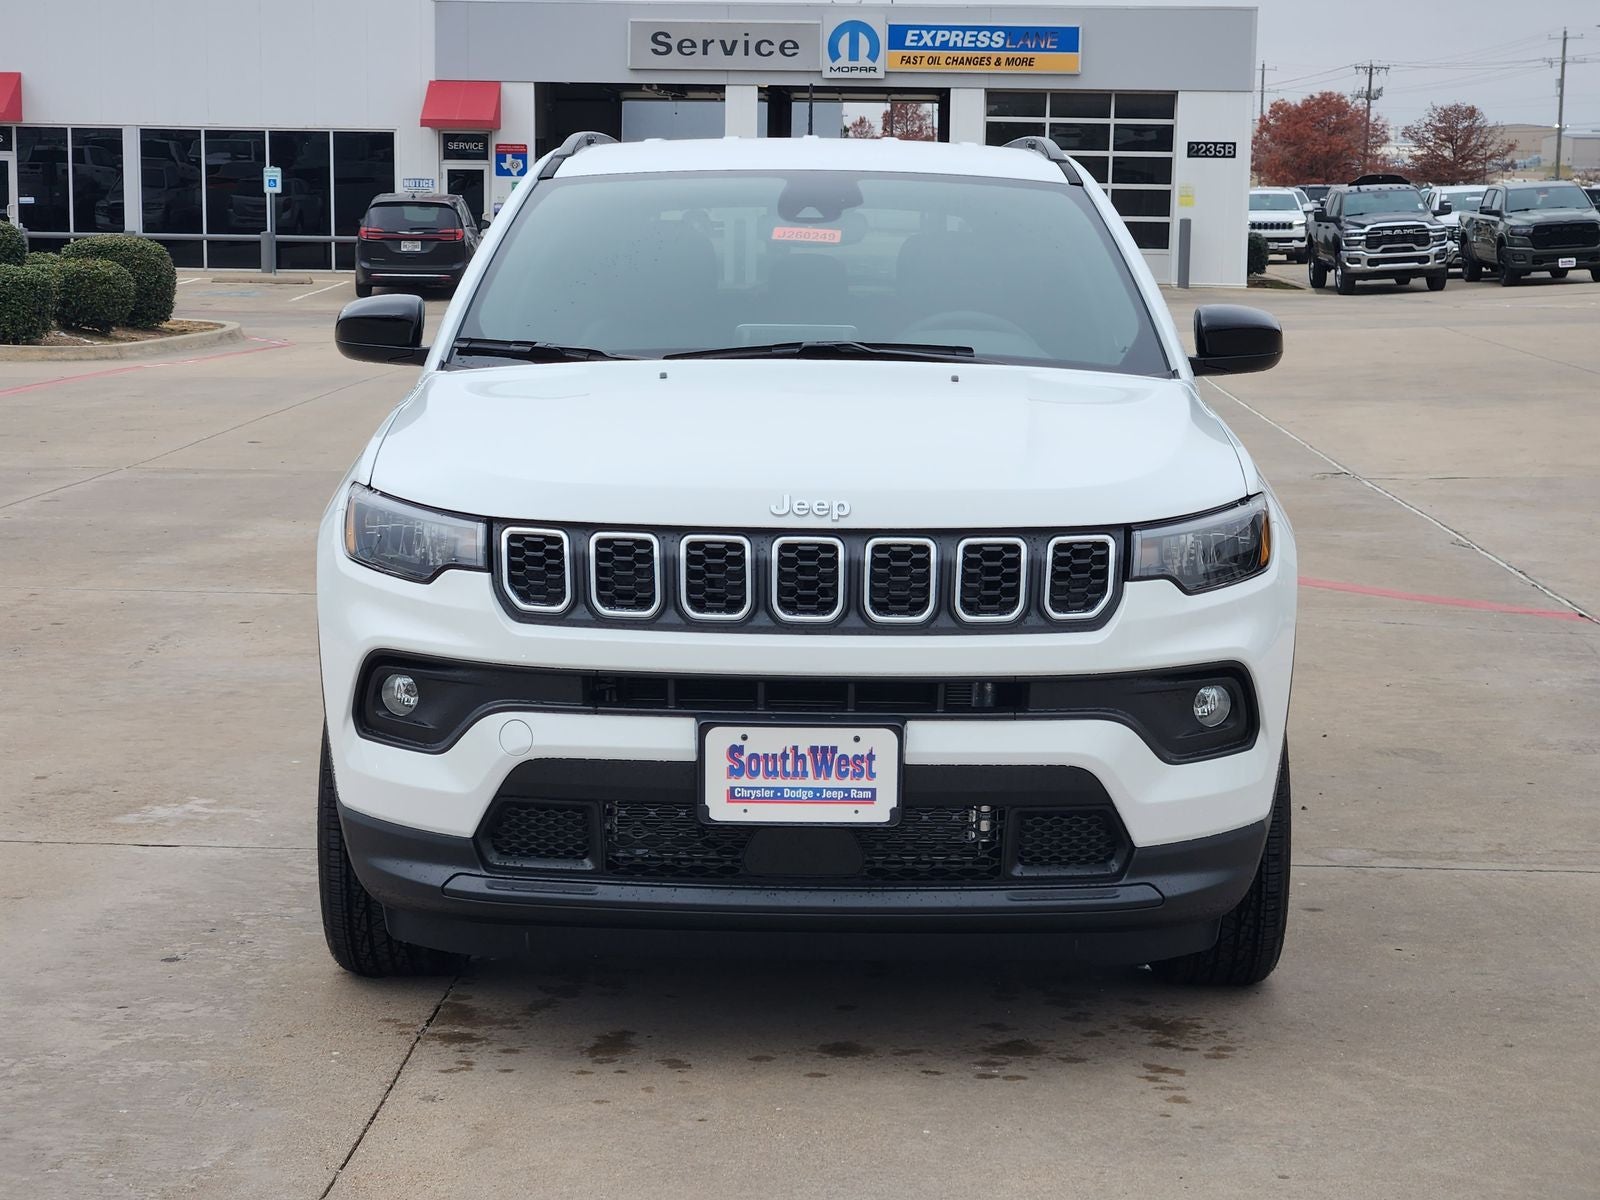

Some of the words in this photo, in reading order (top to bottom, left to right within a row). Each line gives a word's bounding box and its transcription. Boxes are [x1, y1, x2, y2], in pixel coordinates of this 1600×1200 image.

[650, 31, 801, 58] Service
[899, 55, 925, 66] FAST
[928, 55, 942, 66] OIL
[945, 55, 991, 67] CHANGES
[995, 56, 1002, 67] &
[1005, 56, 1035, 67] MORE
[448, 141, 484, 150] SERVICE
[1189, 143, 1235, 156] 2235B
[403, 179, 433, 187] NOTICE
[771, 494, 851, 521] Jeep
[734, 787, 774, 800] Chrysler
[783, 788, 813, 800] Dodge
[821, 789, 843, 800] Jeep
[850, 789, 872, 799] Ram
